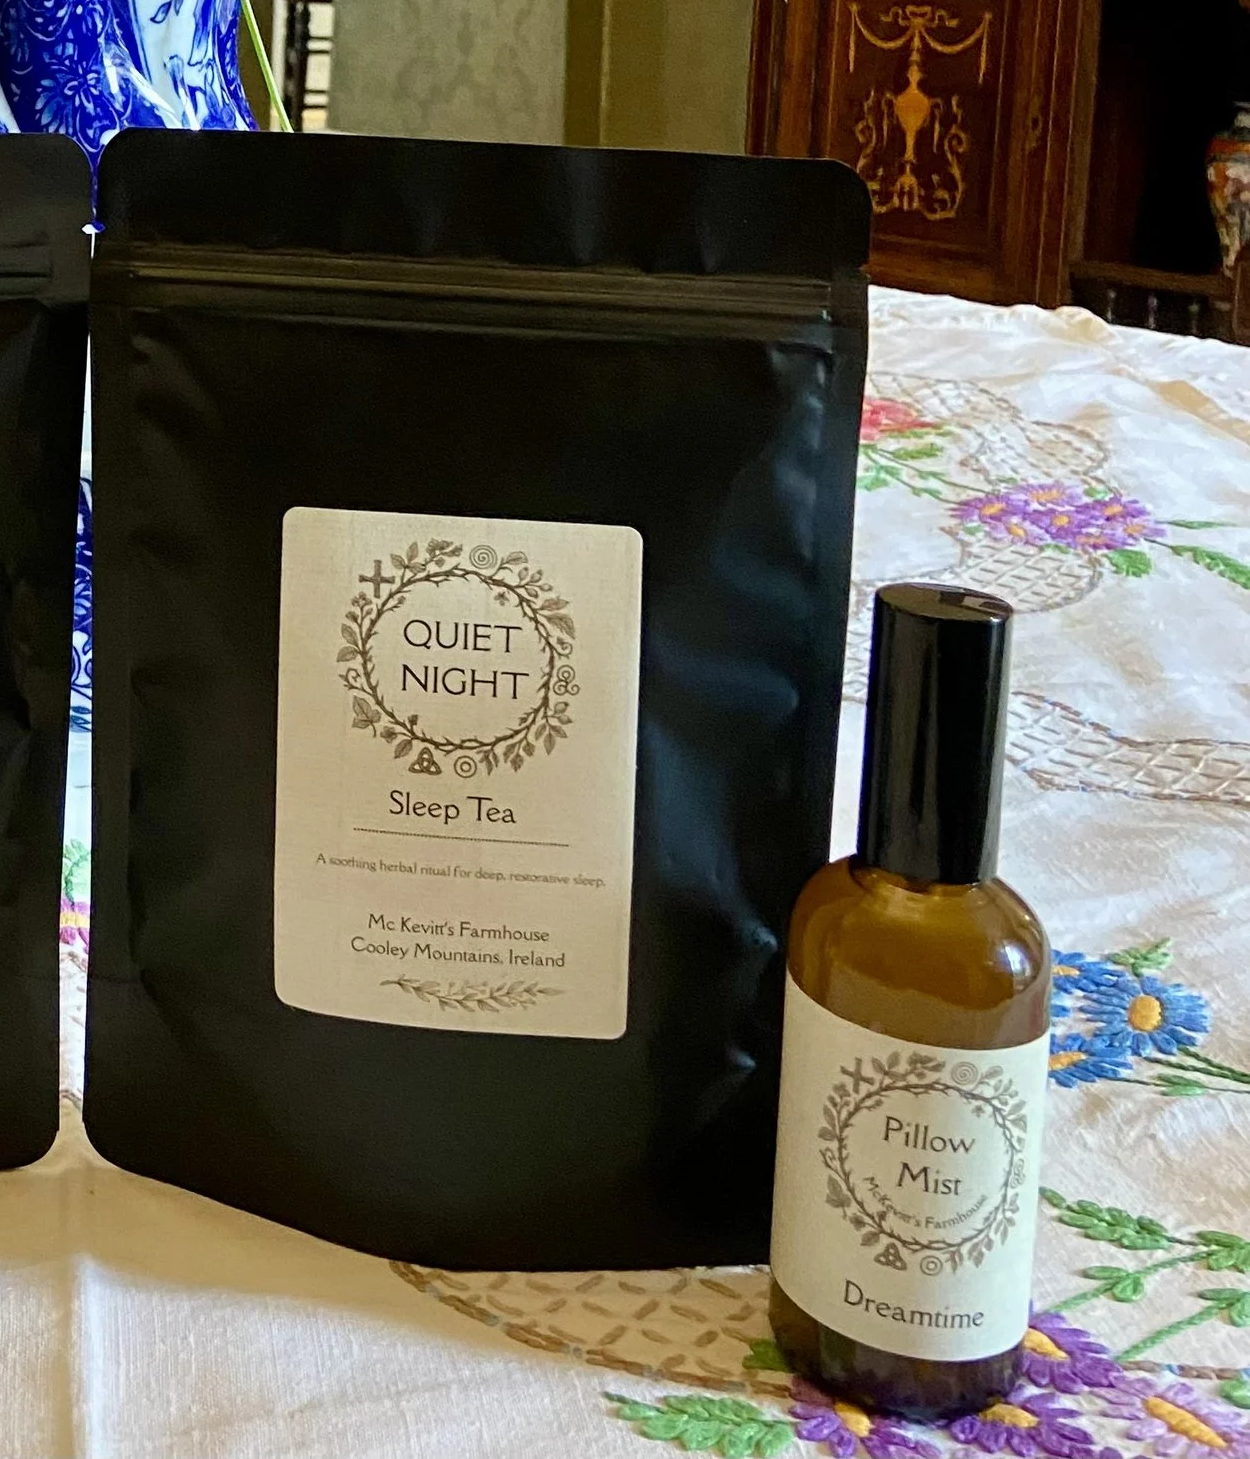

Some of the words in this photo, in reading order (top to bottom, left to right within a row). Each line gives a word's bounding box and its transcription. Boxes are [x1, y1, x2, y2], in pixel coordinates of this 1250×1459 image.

[403, 619, 523, 653] QUIET
[401, 664, 529, 700] NIGHT
[389, 789, 460, 825] Sleep
[467, 795, 517, 824] Tea
[316, 852, 327, 865] A
[329, 856, 377, 872] soothing
[379, 859, 417, 875] herbal
[420, 865, 451, 877] ritual
[453, 865, 472, 878] for
[368, 913, 395, 932] Mc
[400, 916, 454, 936] Kevitt's
[459, 921, 550, 942] Farmhouse
[351, 936, 409, 960] Cooley
[509, 948, 565, 968] Ireland
[883, 1115, 976, 1154] Pillow
[896, 1161, 962, 1196] Mist
[925, 1193, 988, 1230] Farmhouse
[844, 1278, 985, 1329] Dreamtime
